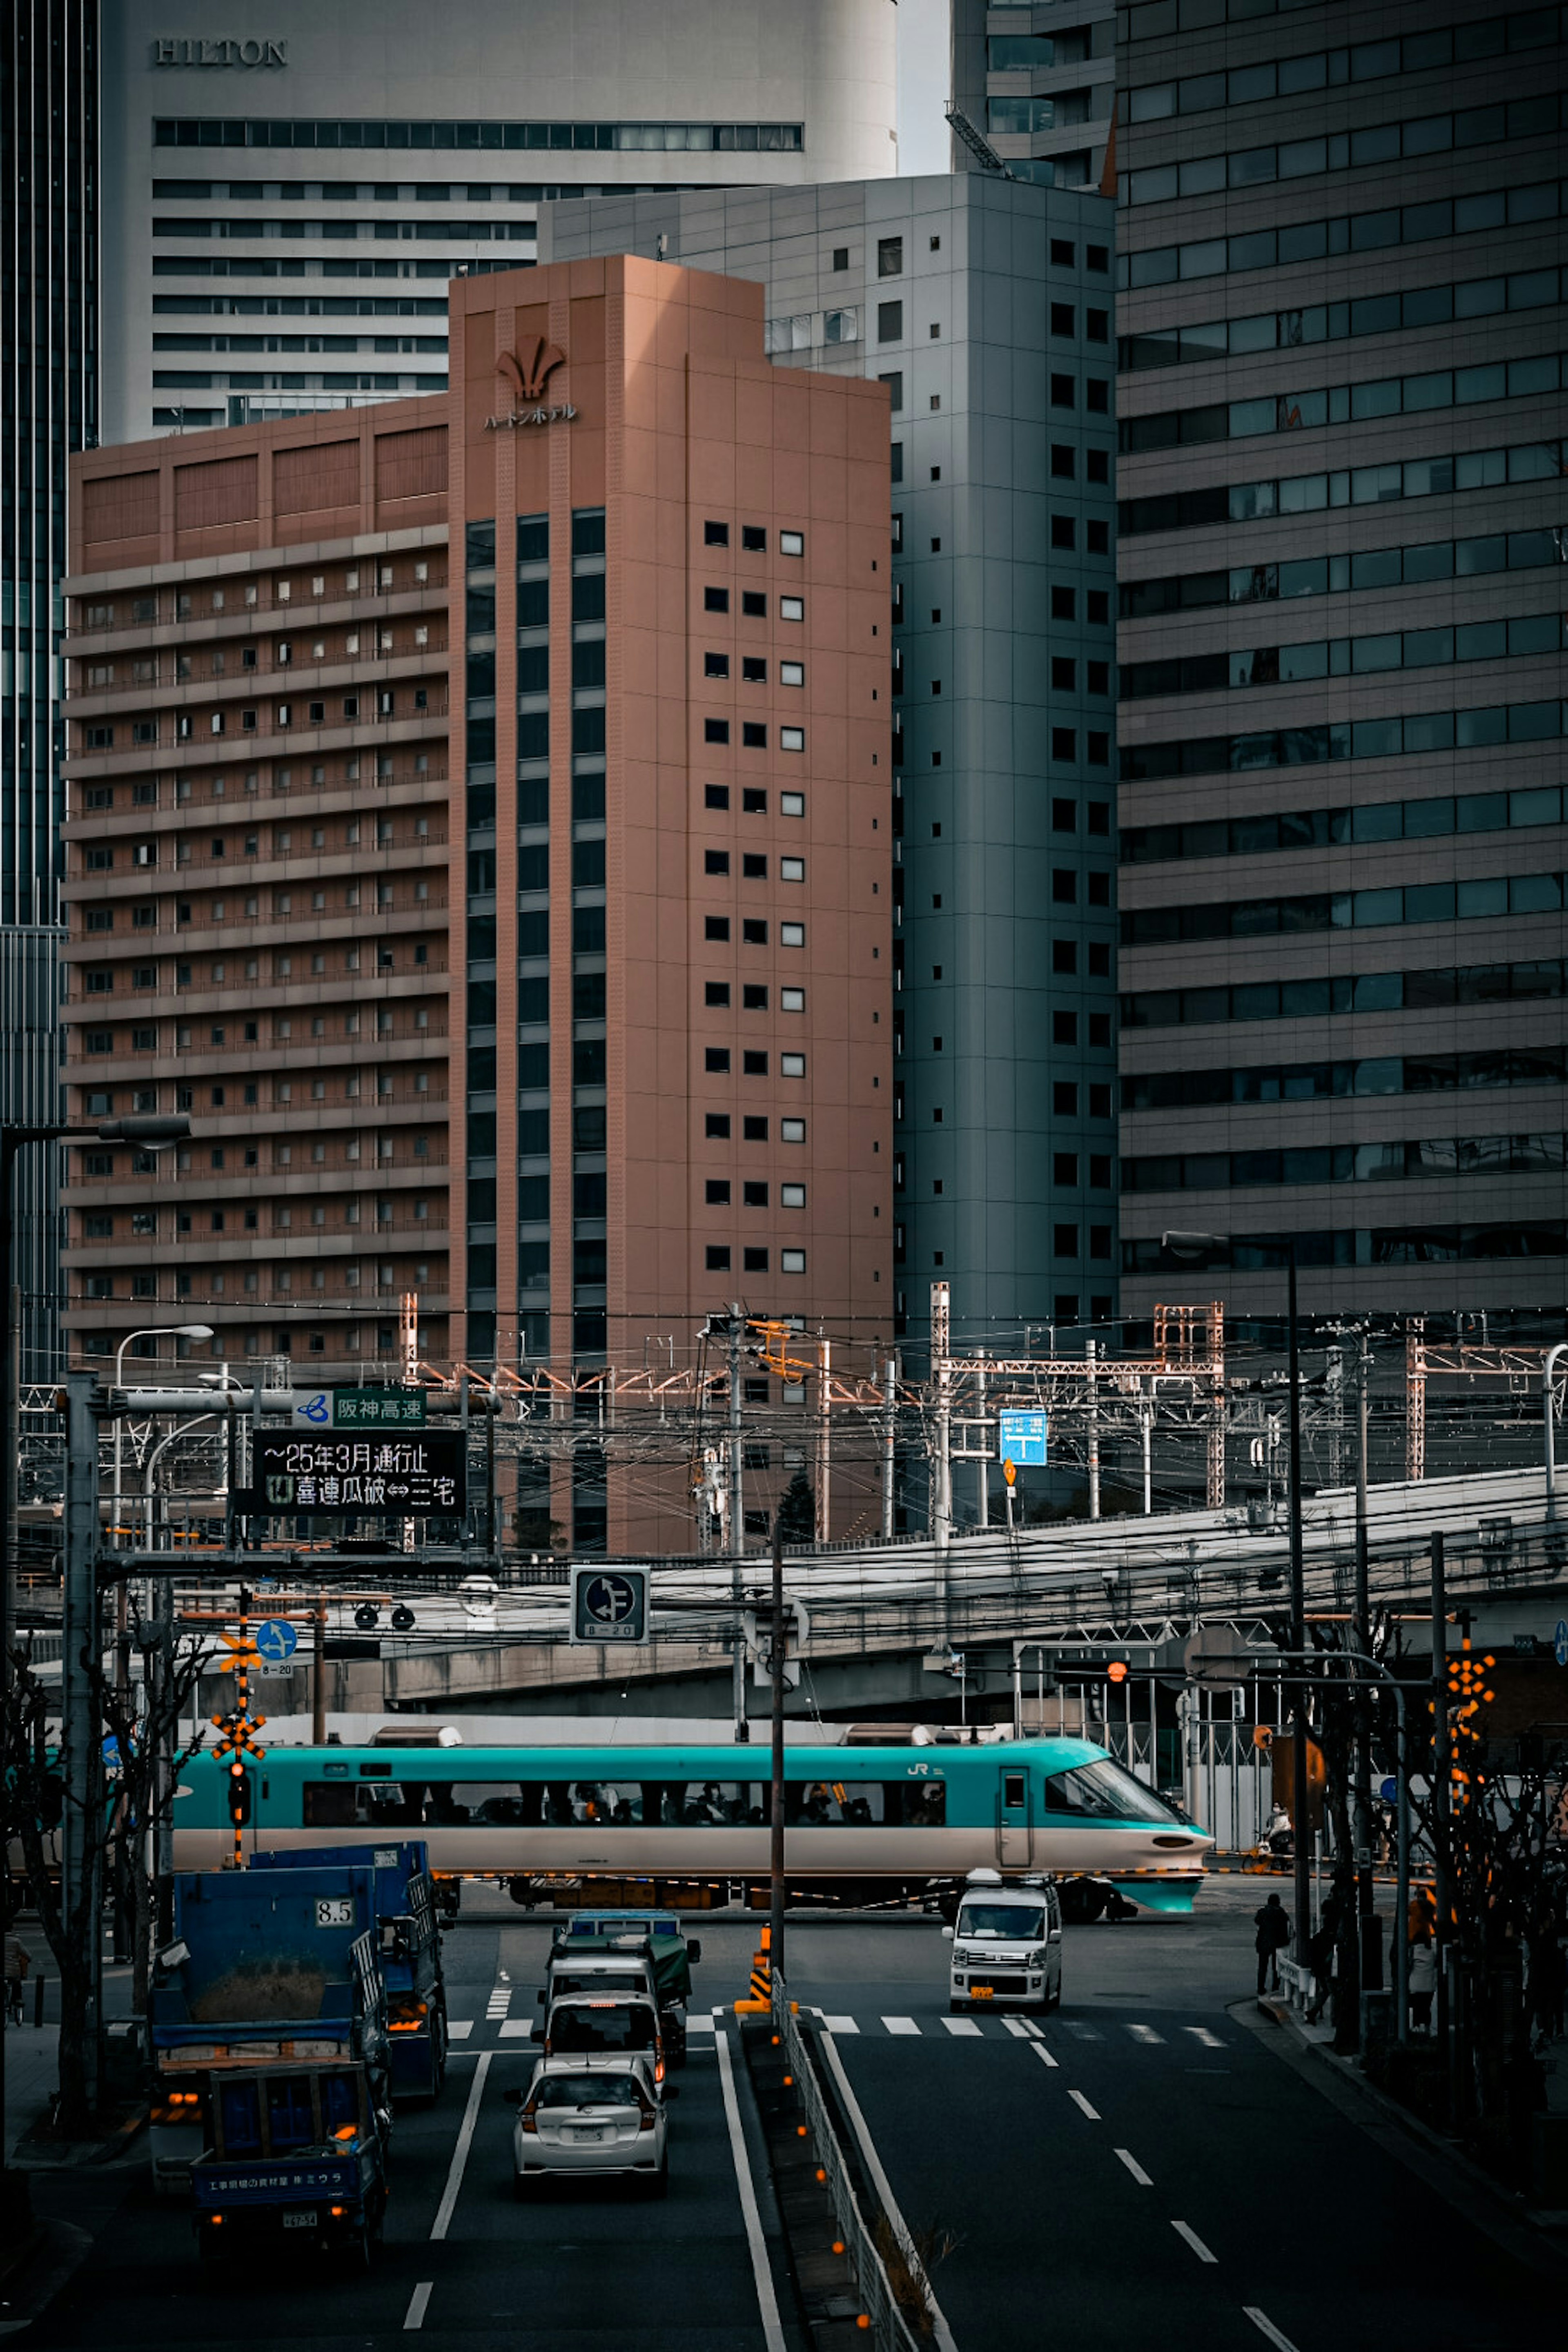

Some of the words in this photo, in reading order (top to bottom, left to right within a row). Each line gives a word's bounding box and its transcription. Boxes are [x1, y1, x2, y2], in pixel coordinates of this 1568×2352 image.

[156, 40, 289, 66] HILTON
[484, 403, 575, 428] ハートンホテル
[338, 1399, 422, 1419] 阪神高速
[263, 1666, 291, 1674] 8-20
[907, 1763, 928, 1775] JR
[319, 1902, 351, 1922] 8.5
